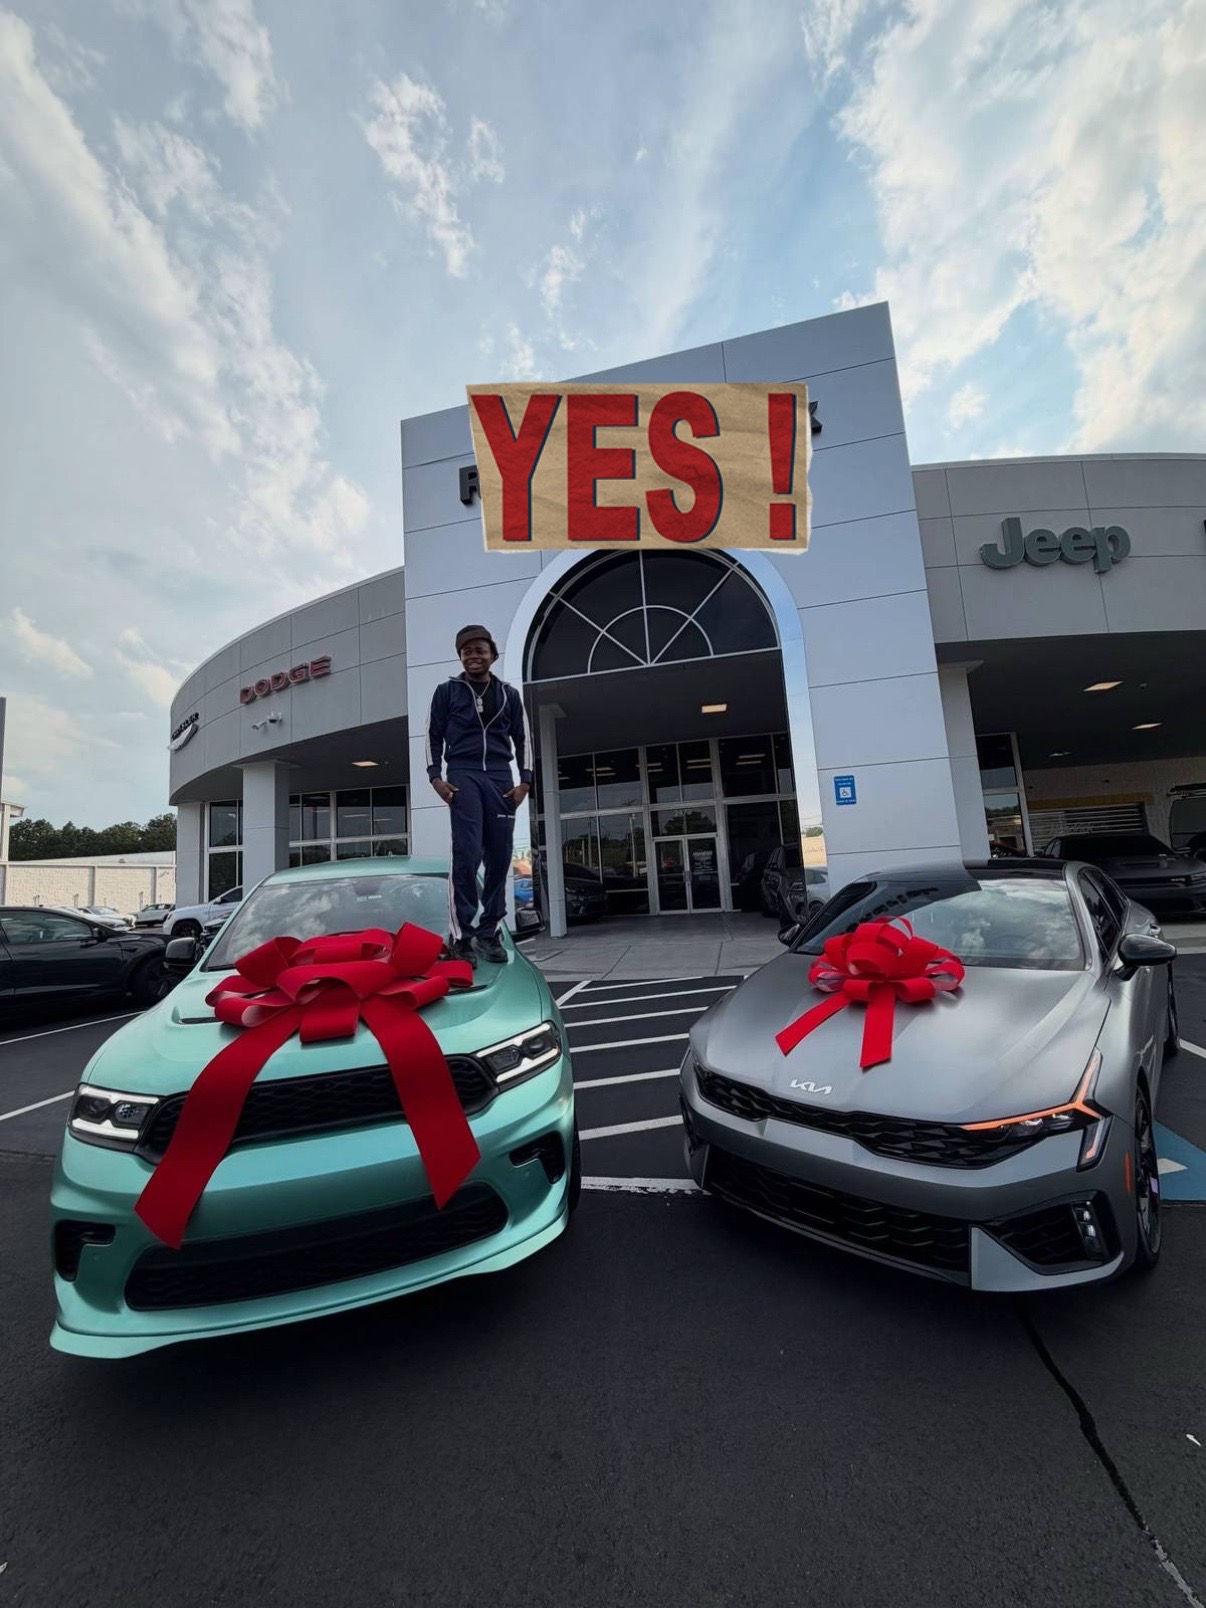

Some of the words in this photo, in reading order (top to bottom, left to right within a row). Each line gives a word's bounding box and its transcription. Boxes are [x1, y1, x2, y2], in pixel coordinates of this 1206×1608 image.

[979, 516, 1131, 575] Jeep
[240, 655, 332, 705] DODGE
[790, 1079, 832, 1095] KIA
